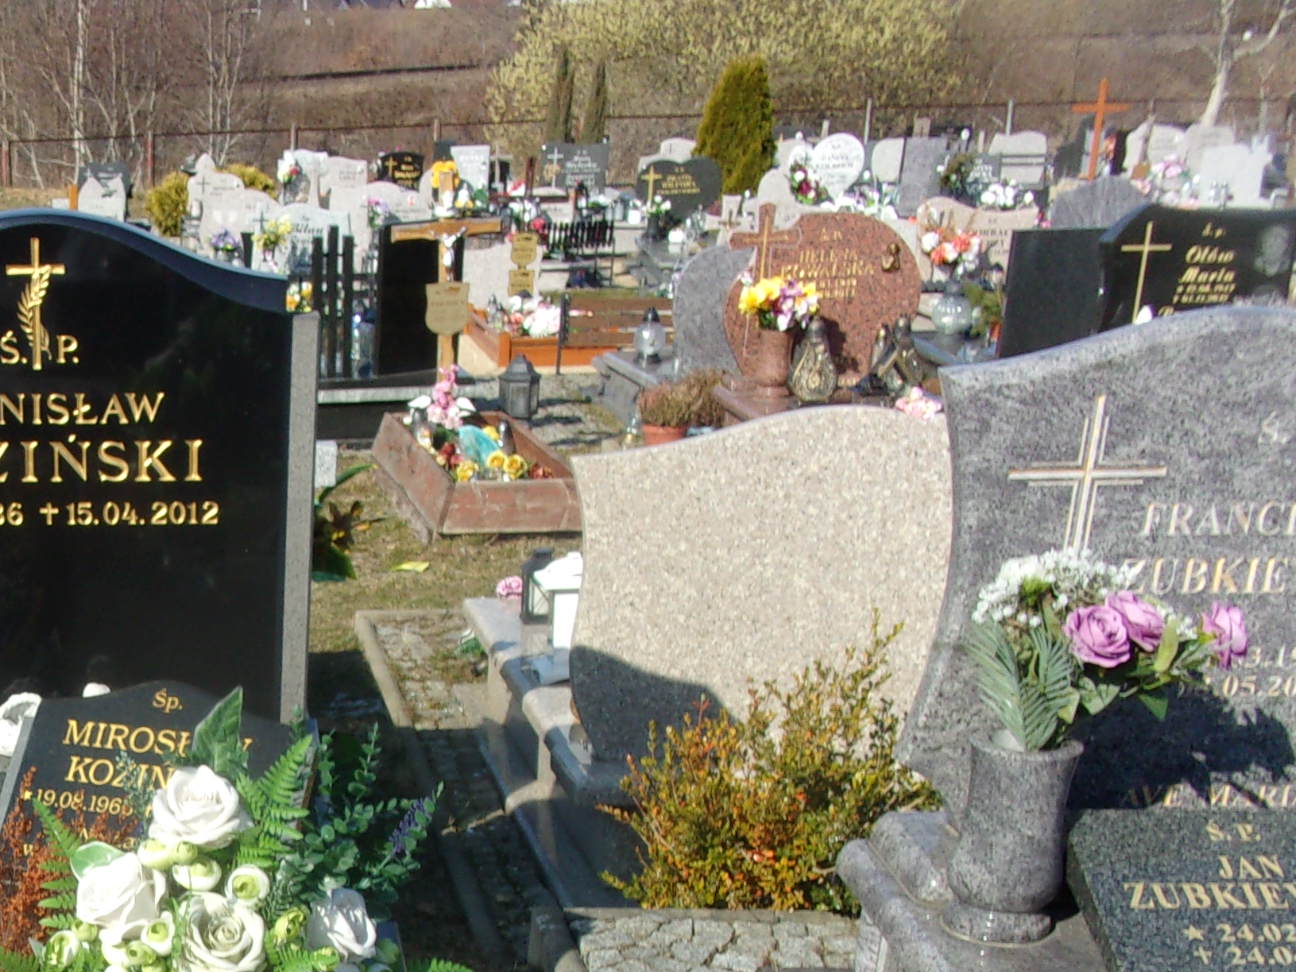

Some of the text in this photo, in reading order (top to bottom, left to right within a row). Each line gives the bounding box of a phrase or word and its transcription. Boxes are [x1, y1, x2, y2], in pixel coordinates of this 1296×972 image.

[57, 335, 80, 365] P.
[65, 501, 220, 527] 15.04.2012
[62, 718, 253, 758] MIROSŁ
[64, 756, 177, 791] KOZIŃ
[1218, 855, 1285, 880] JAN
